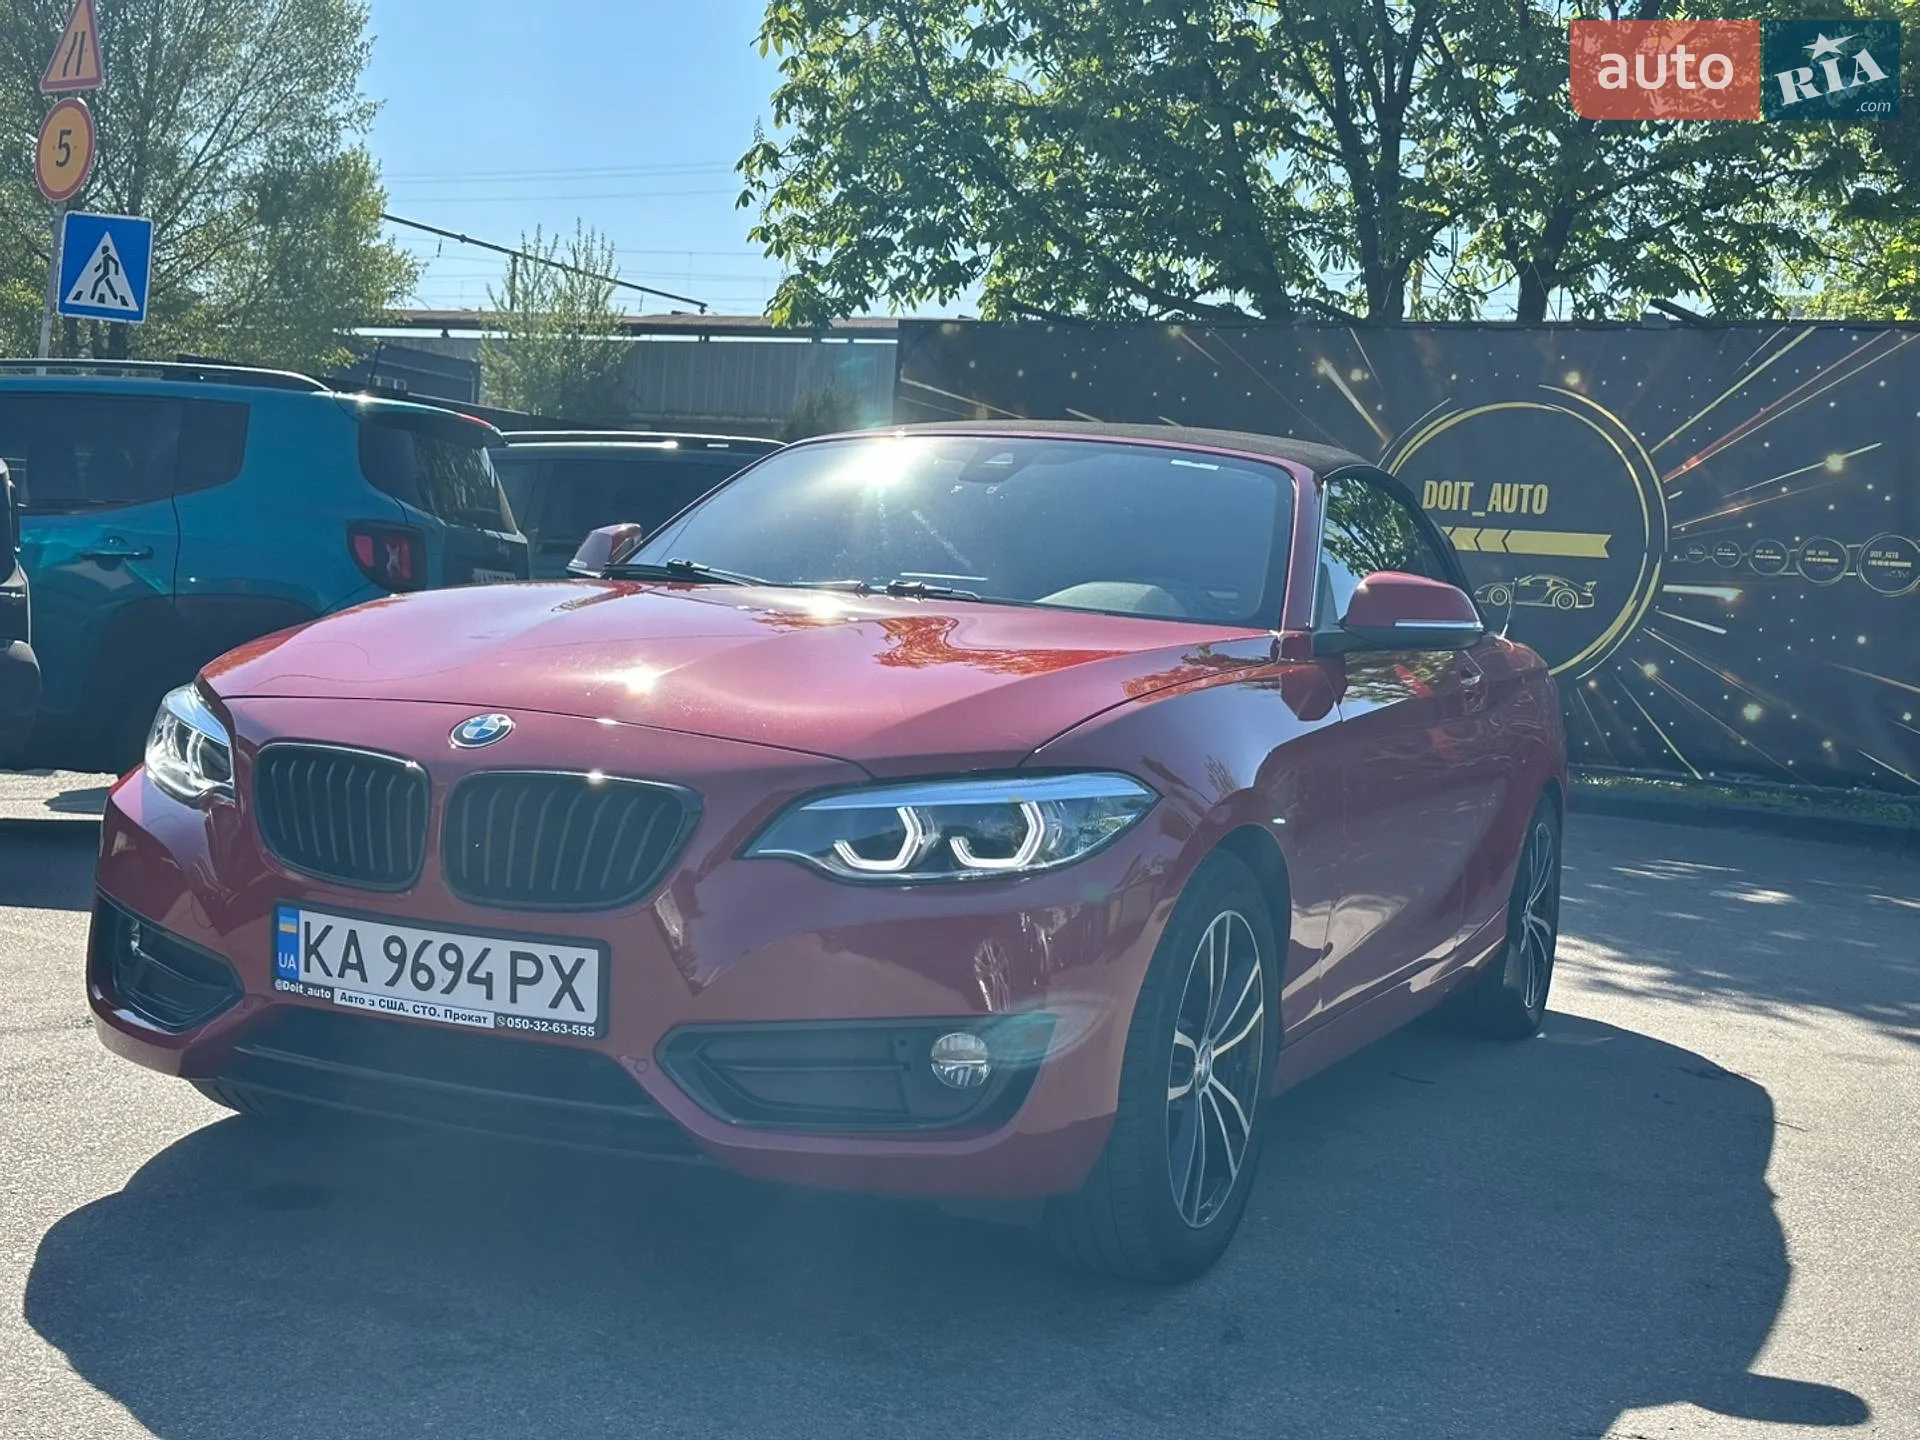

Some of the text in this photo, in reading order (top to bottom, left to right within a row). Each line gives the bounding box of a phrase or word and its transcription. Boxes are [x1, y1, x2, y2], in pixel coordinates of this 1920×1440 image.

[56, 129, 72, 167] 5
[1422, 479, 1549, 517] DOIT_AUTO
[278, 953, 297, 970] UA
[303, 921, 586, 1012] KA 9694 PX
[340, 992, 365, 1005] Авто
[378, 998, 409, 1013] США.
[412, 1004, 440, 1018] СТО.
[444, 1009, 488, 1025] Прокат
[506, 1017, 595, 1037] 050-32-63-555
